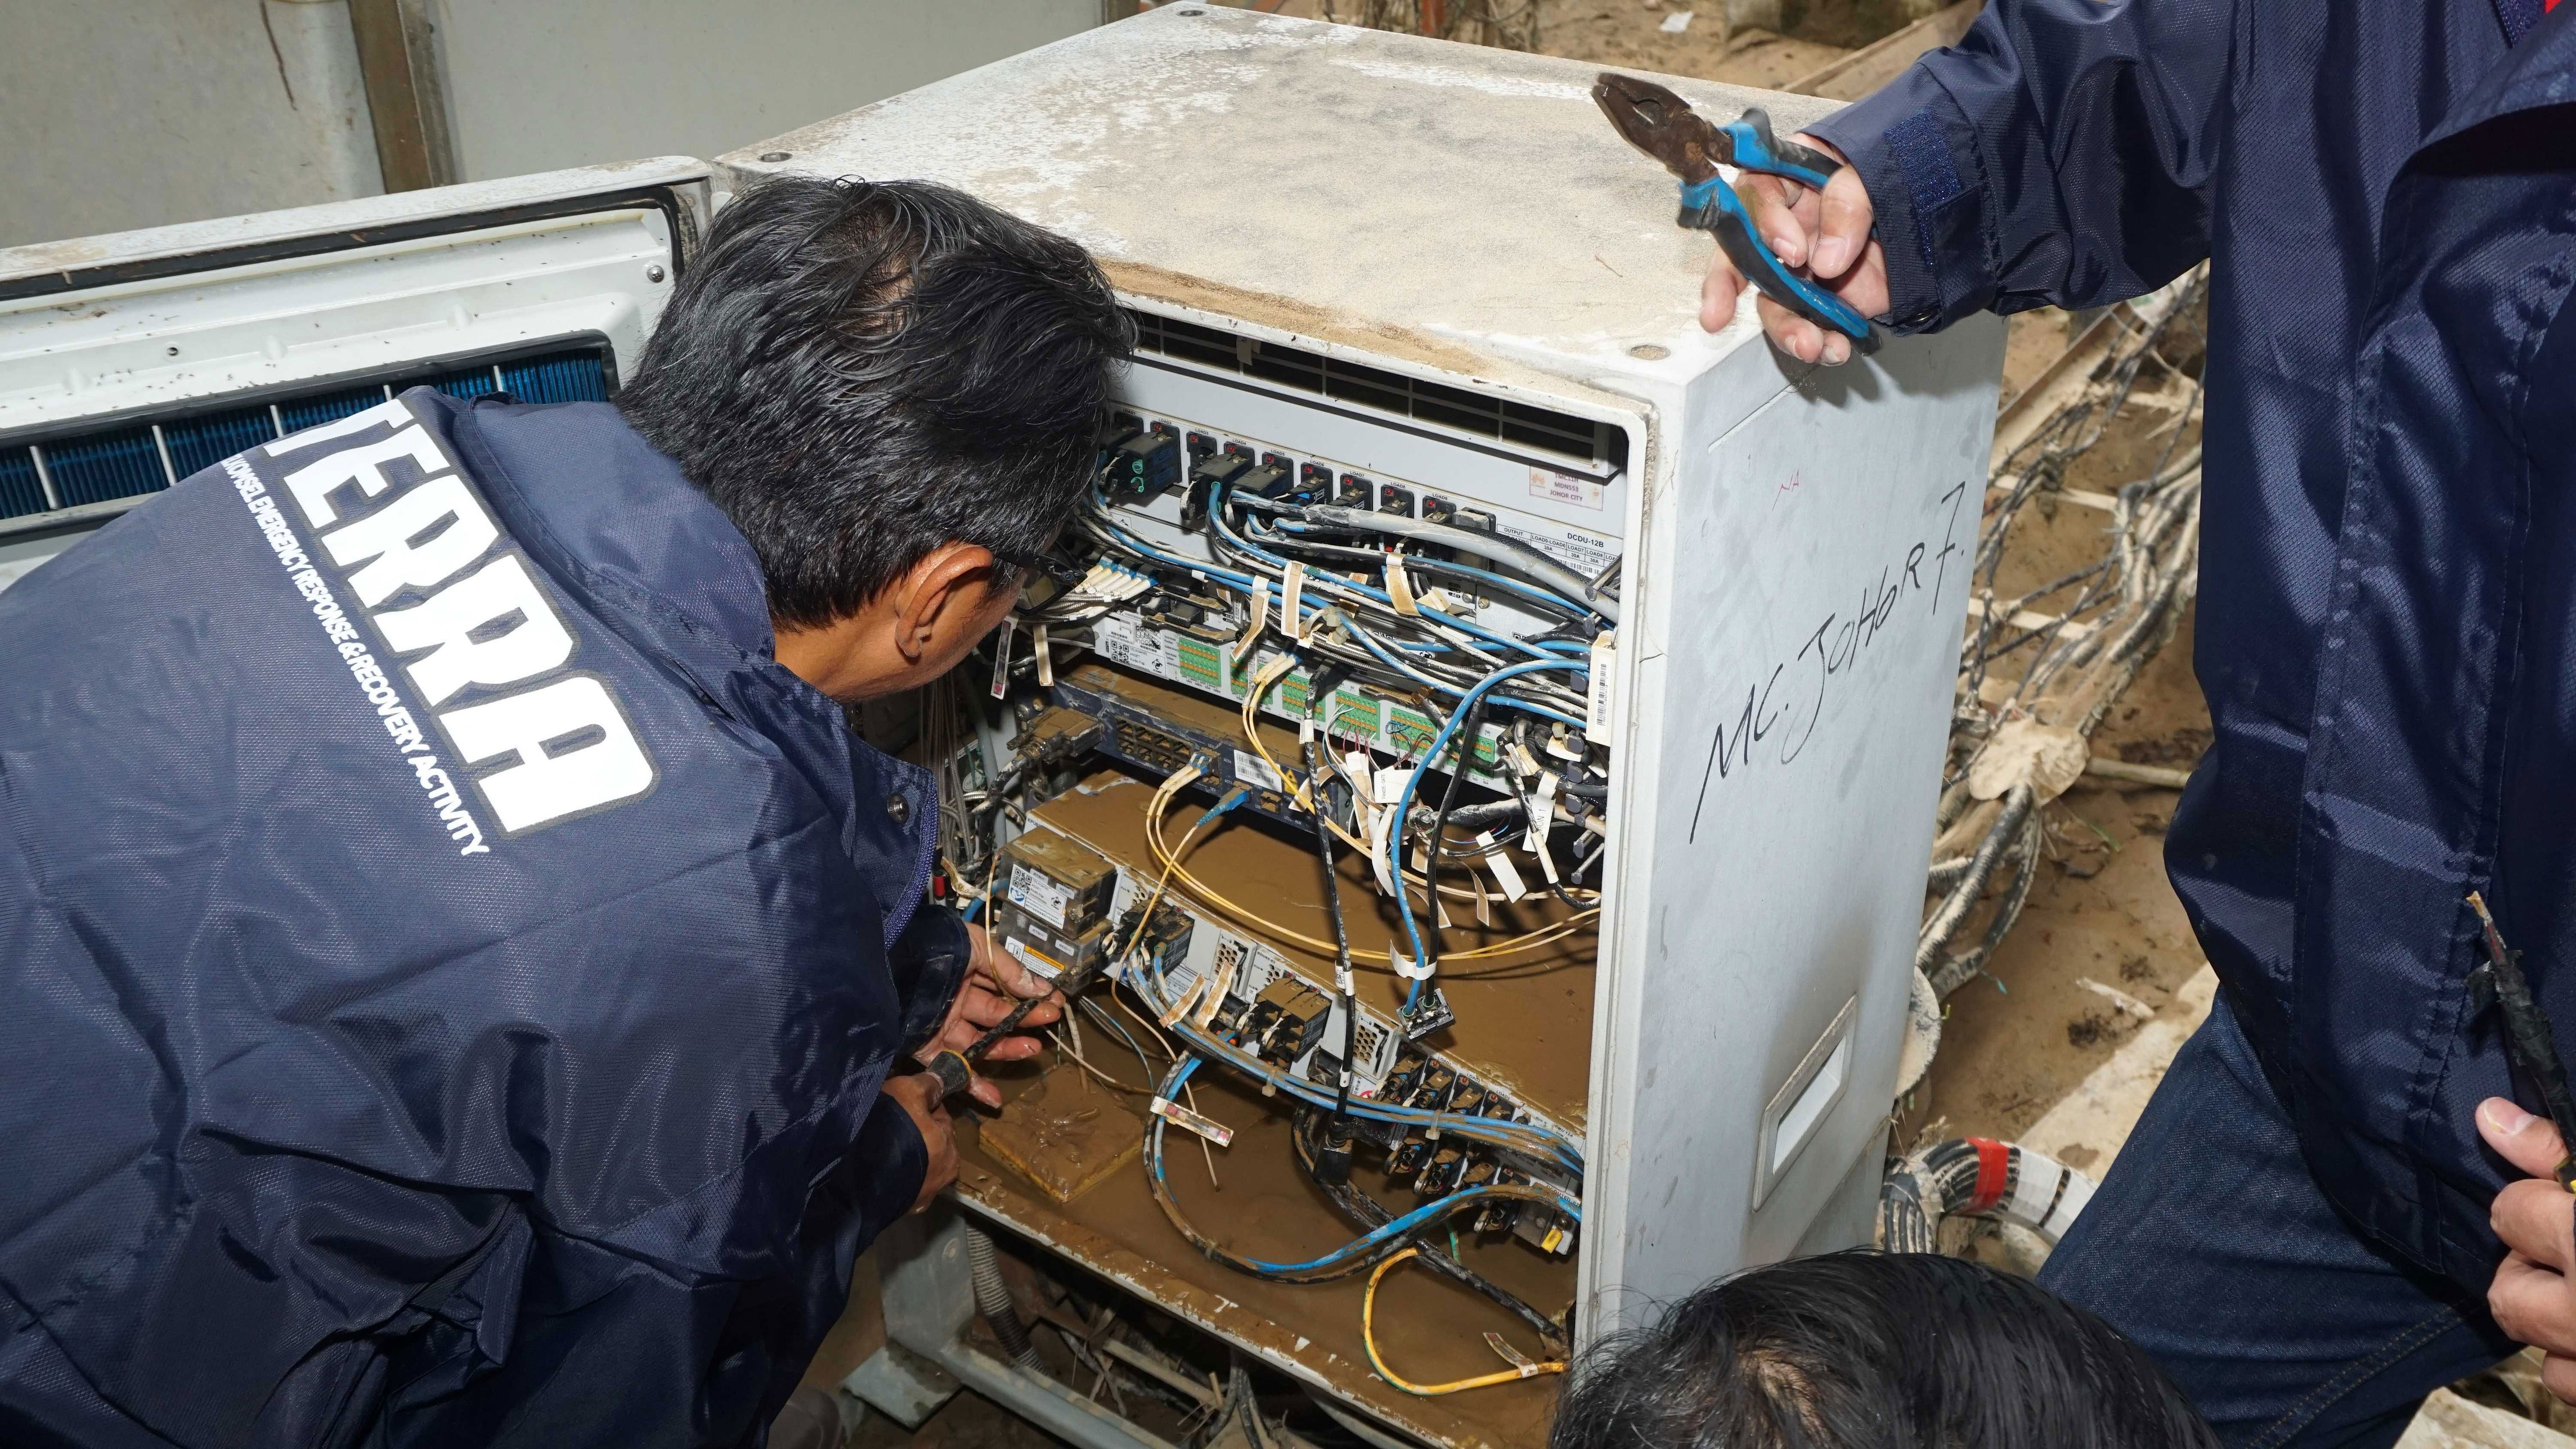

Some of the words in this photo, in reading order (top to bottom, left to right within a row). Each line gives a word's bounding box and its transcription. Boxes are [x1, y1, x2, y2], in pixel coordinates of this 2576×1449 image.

[1550, 490, 1569, 500] JOHOR
[248, 496, 313, 572] EMERGENCY
[1504, 528, 1523, 536] OUTPUT
[1568, 533, 1604, 547] DCDU-12B
[1532, 535, 1566, 548] LOAD0-LOAD6
[264, 399, 653, 832] TERRA
[291, 569, 359, 645] RESPONSE
[338, 642, 366, 660] &
[347, 654, 430, 753] RECOVERY
[407, 756, 490, 856] ACTIVITY
[1438, 1056, 1452, 1066] LOAD1
